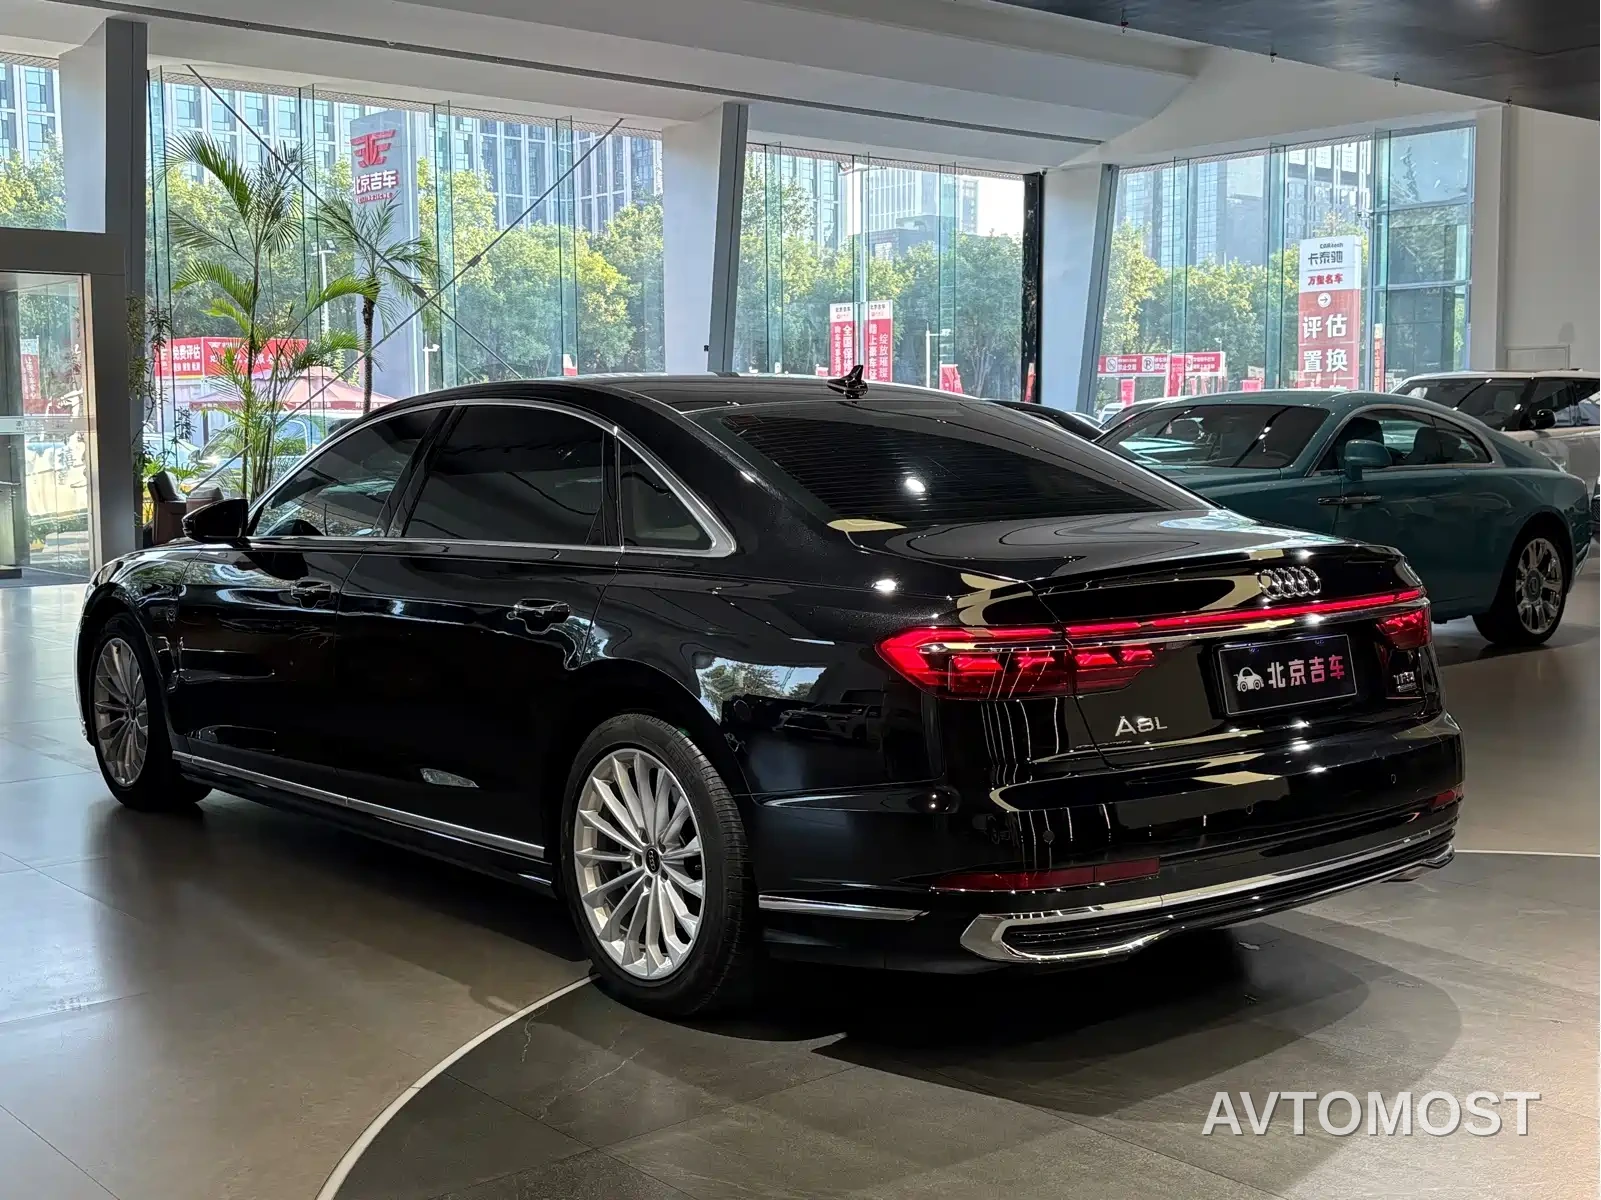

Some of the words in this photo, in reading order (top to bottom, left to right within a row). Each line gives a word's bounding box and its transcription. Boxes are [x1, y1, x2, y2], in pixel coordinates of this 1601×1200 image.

[350, 169, 398, 195] 北京吉车
[1307, 250, 1343, 265] 卡泰驰
[1302, 313, 1348, 339] 评估
[879, 332, 889, 381] 绽放璀璨
[1303, 348, 1348, 373] 置换
[1266, 654, 1345, 689] 北京吉车
[1115, 716, 1168, 737] A8L
